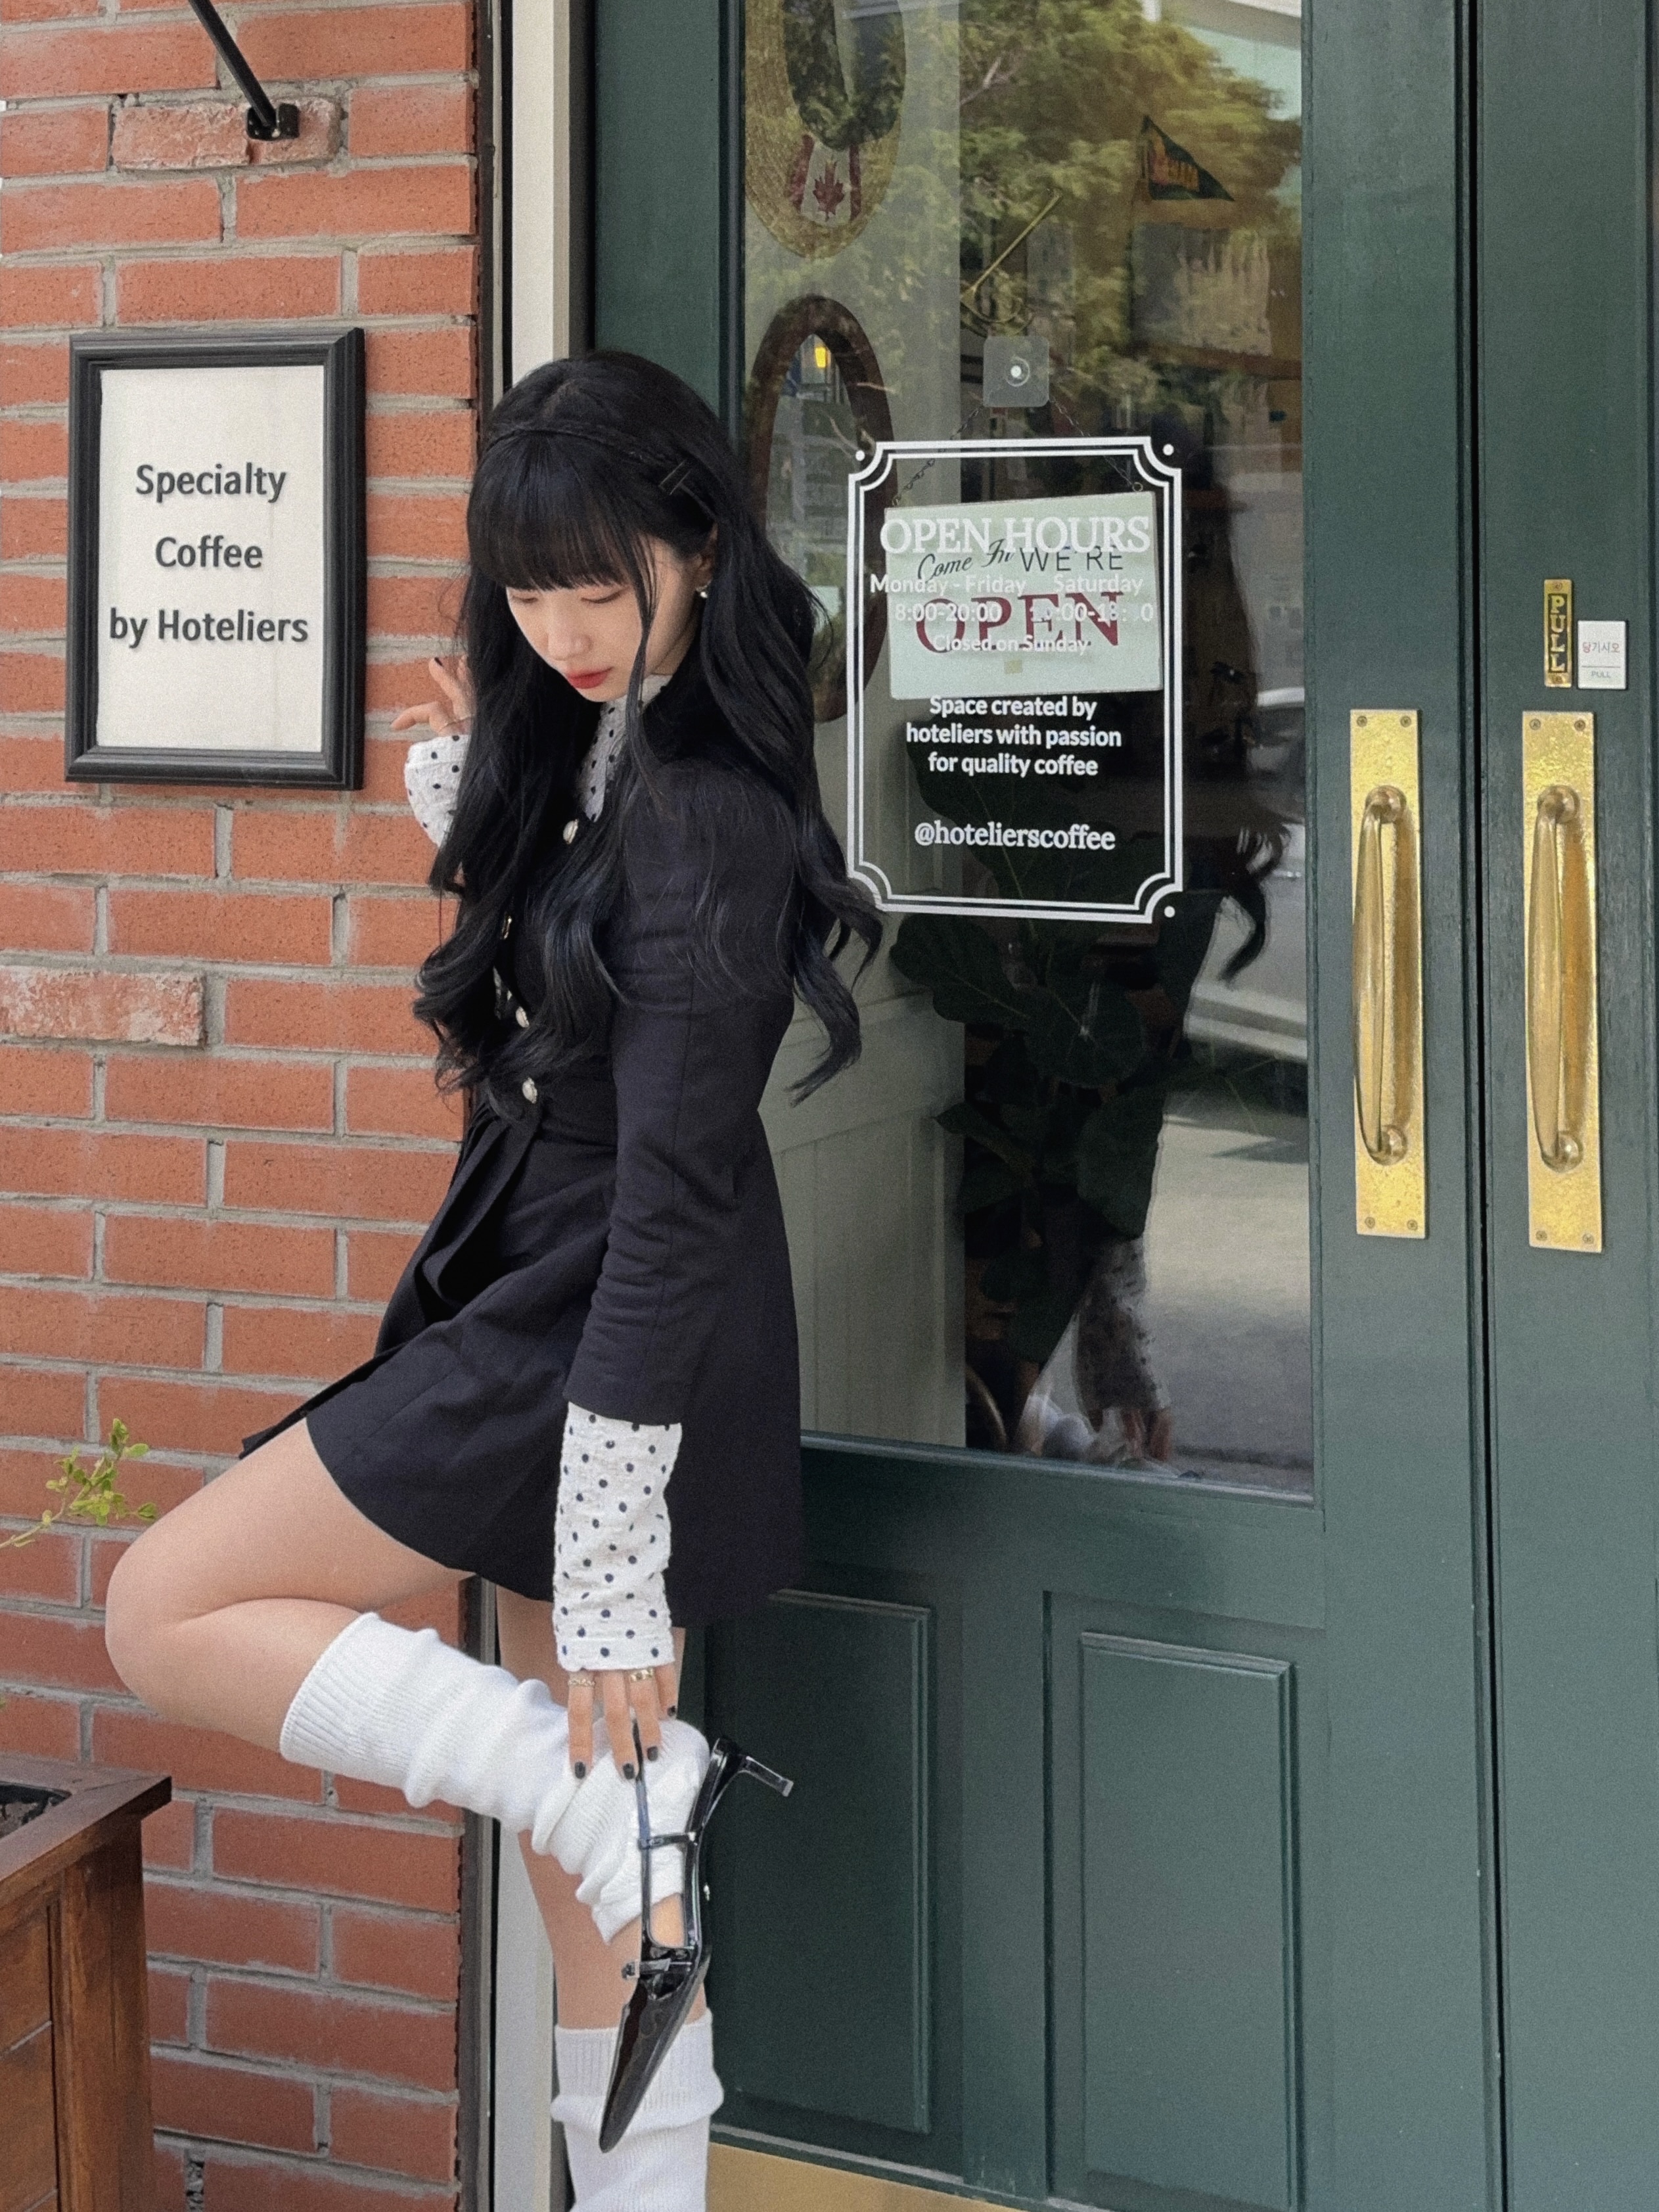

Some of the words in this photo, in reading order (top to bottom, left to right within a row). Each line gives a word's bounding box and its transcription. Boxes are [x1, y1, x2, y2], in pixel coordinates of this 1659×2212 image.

[135, 461, 286, 503] Specialty
[880, 518, 992, 554] OPEN
[1003, 516, 1150, 553] HOURS
[155, 534, 263, 568] Coffee
[917, 553, 973, 584] Come
[870, 573, 948, 596] Monday
[965, 574, 1026, 597] Friday
[1053, 573, 1143, 596] Saturday
[894, 602, 1003, 622] 8:00-20:00
[916, 591, 1125, 653] OPEN
[110, 607, 148, 649] by
[158, 609, 309, 642] Hoteliers
[1550, 595, 1566, 672] PULL
[933, 634, 992, 651] Closed
[995, 639, 1018, 651] on
[1020, 634, 1088, 656] Sunday
[1582, 641, 1620, 653] 당기시오
[929, 695, 988, 718] Space
[991, 695, 1068, 716] created
[1072, 695, 1098, 721] by
[906, 722, 993, 744] hoteliers
[995, 724, 1042, 745] with
[1045, 725, 1122, 749] passion
[928, 751, 959, 772] for
[961, 752, 1031, 778] quality
[1034, 754, 1099, 776] coffee
[914, 819, 1116, 850] @hotelierscoffee
